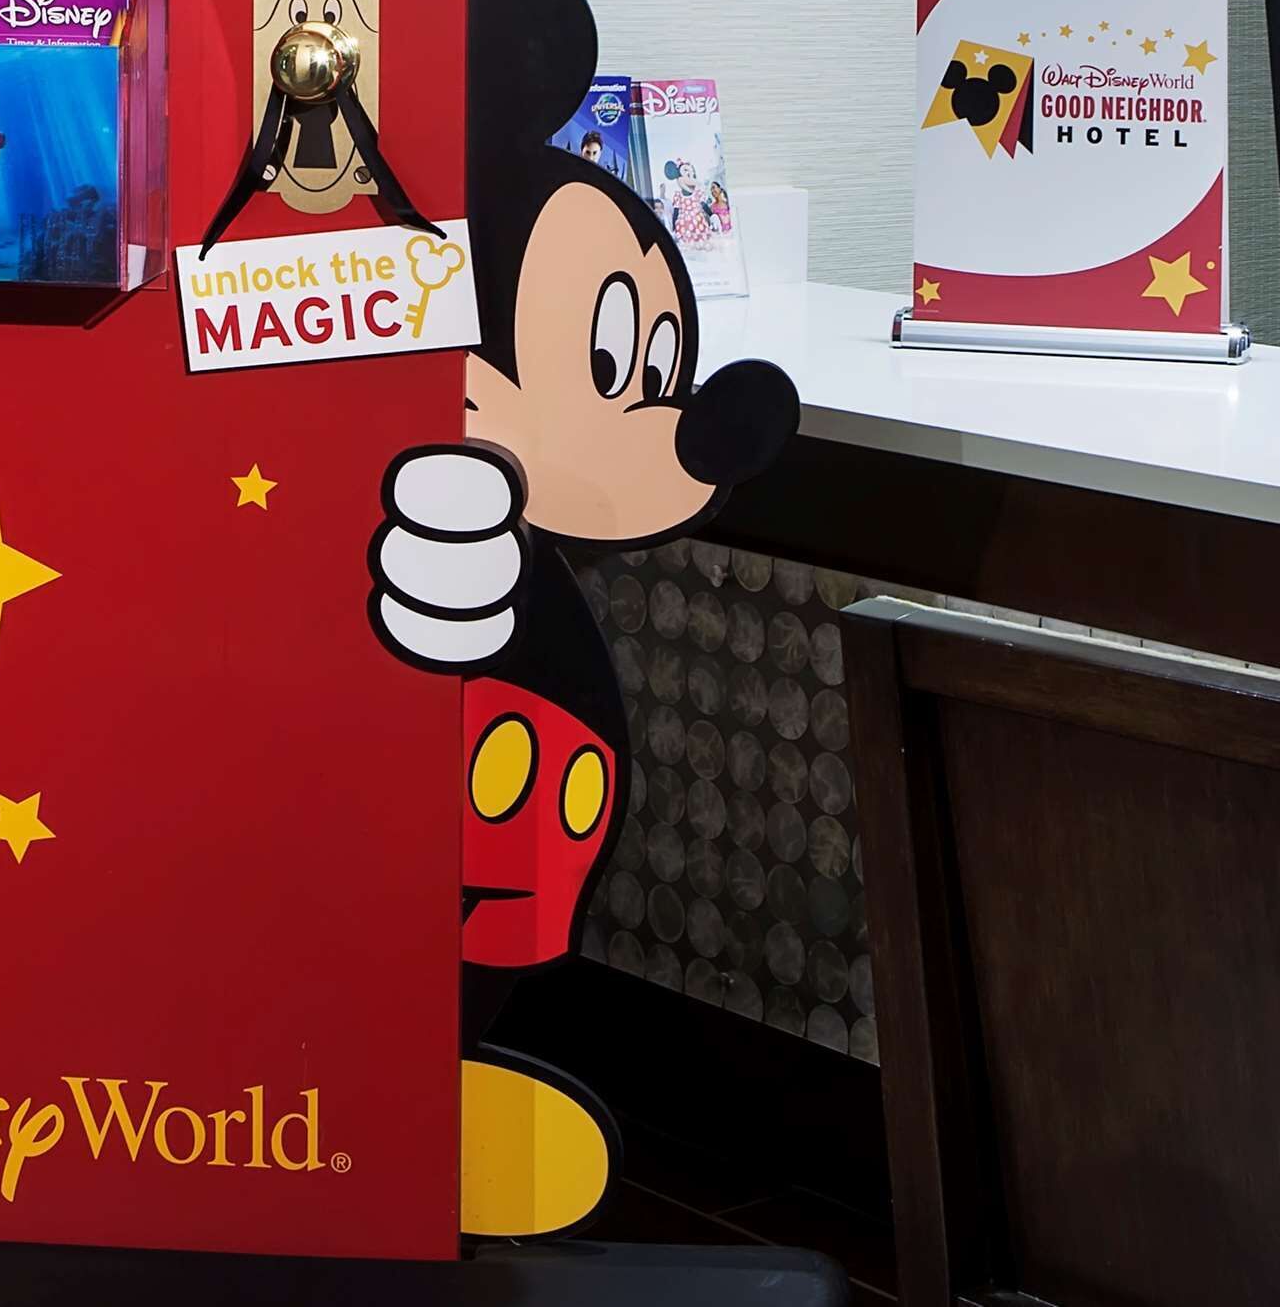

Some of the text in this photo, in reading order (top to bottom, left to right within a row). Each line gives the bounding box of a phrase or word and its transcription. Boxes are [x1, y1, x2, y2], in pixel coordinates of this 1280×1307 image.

[1042, 63, 1194, 95] Walt Disney World
[1041, 94, 1095, 119] GOOD
[1057, 126, 1187, 147] HOTEL
[190, 251, 395, 297] unlock the
[195, 290, 402, 354] MAGIC
